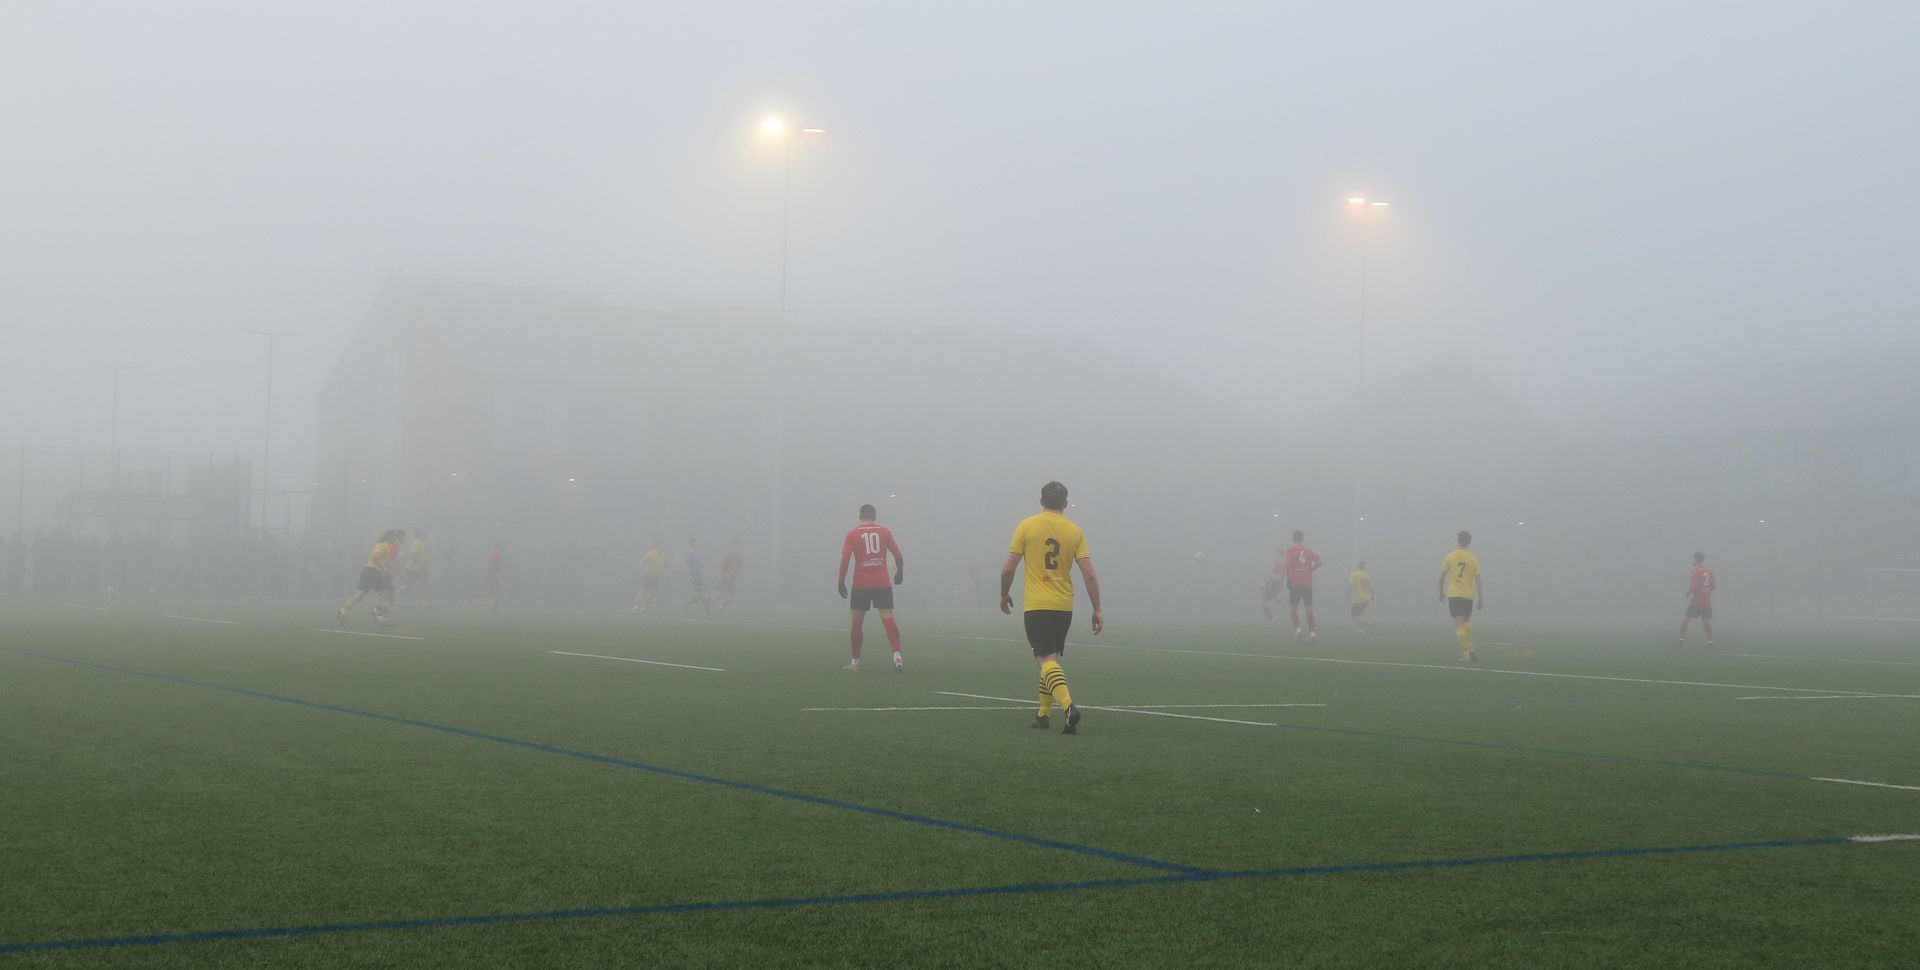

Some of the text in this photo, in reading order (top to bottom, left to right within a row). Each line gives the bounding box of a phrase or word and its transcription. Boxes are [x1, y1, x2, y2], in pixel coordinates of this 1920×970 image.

[861, 532, 881, 554] 10
[1045, 537, 1060, 570] 2
[1298, 550, 1306, 565] 4
[1458, 561, 1467, 577] 7
[1703, 571, 1710, 586] 3
